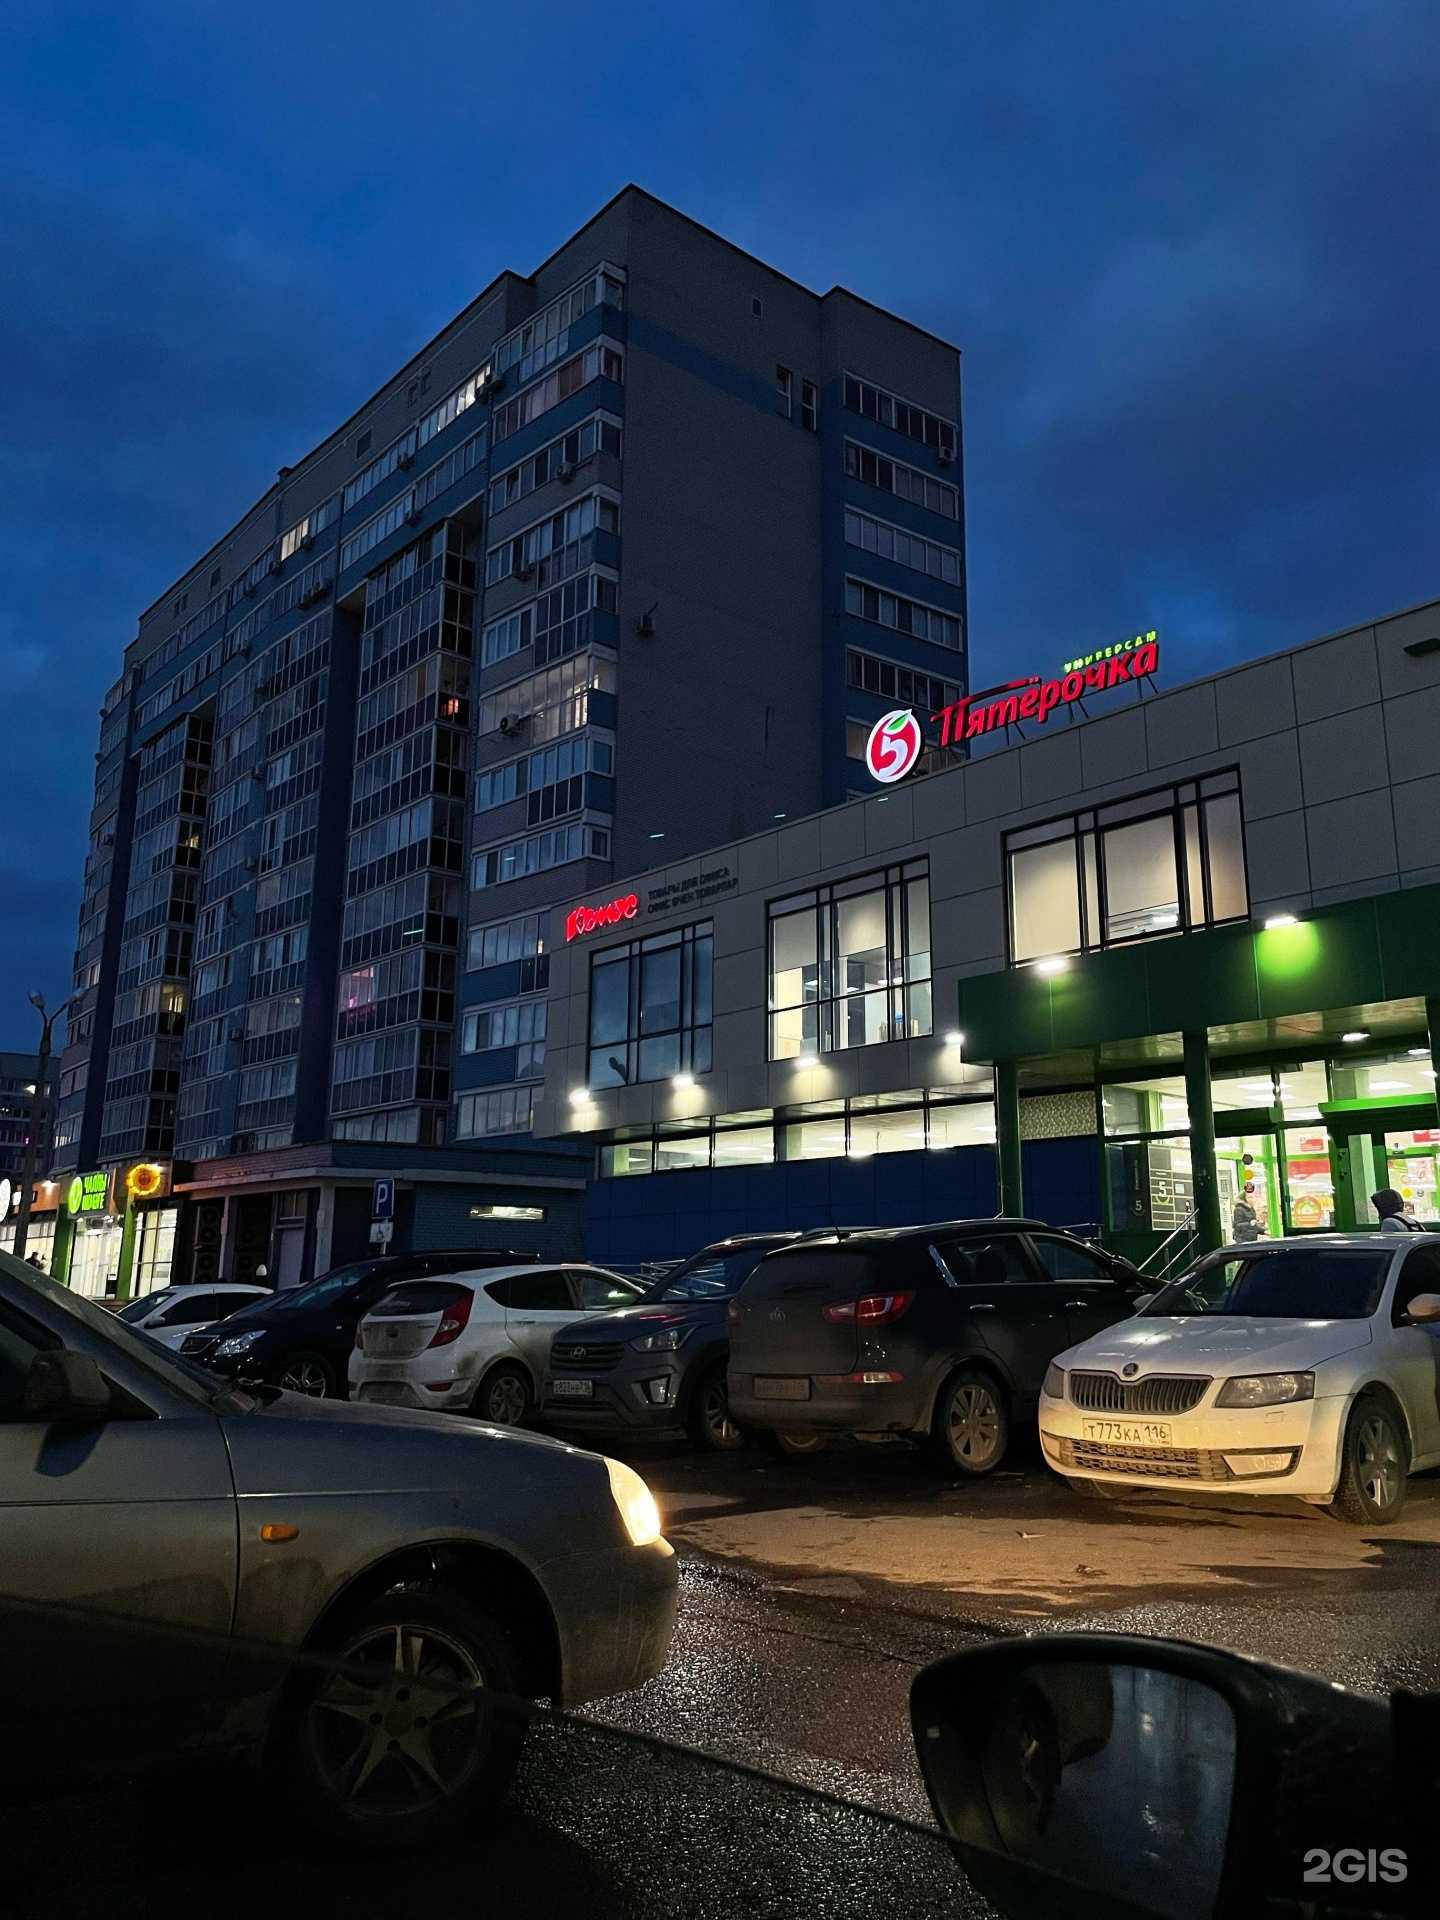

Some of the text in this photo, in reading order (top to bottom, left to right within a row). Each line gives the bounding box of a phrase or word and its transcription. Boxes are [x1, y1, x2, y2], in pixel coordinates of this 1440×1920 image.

[1064, 631, 1156, 673] УНИВЕРСАМ
[930, 643, 1159, 748] Пятёрочка
[1144, 1424, 1167, 1439] 116
